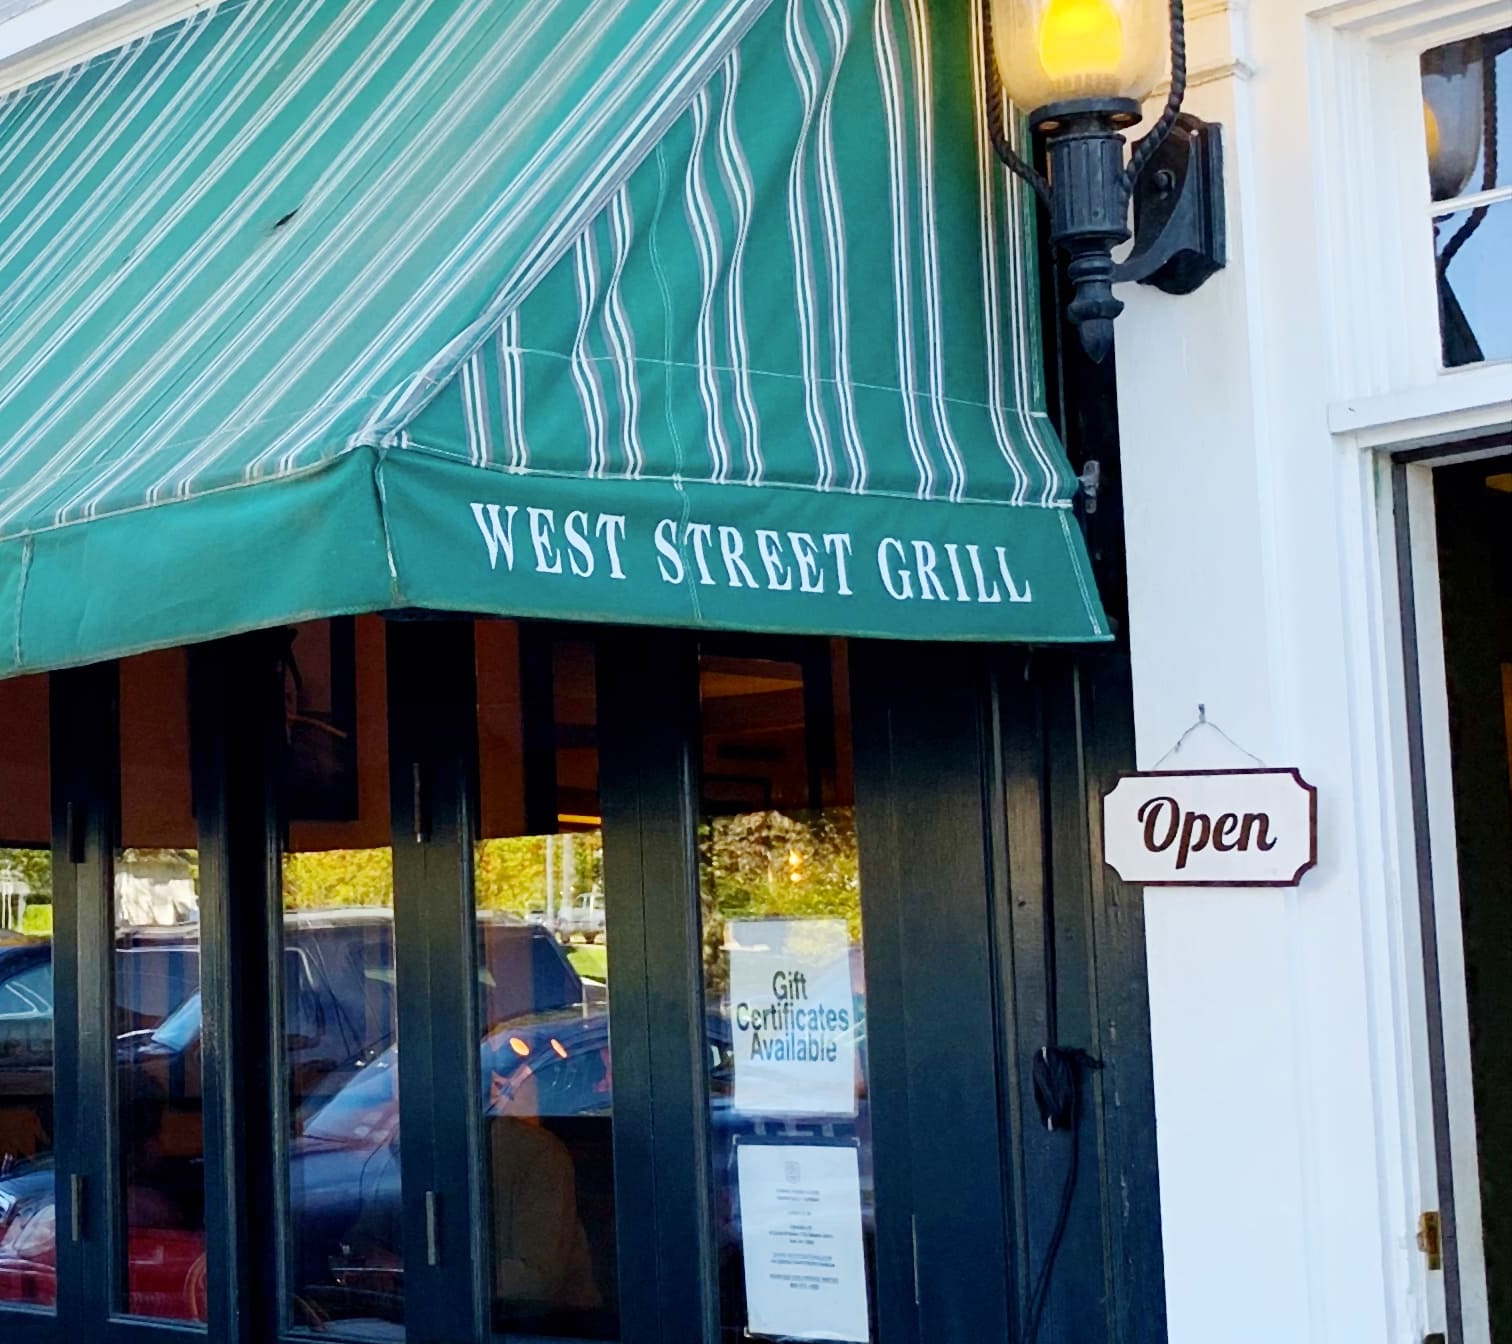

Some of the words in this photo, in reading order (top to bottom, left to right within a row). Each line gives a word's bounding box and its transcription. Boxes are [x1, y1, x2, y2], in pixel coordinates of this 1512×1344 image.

[469, 501, 627, 580] WEST
[654, 517, 855, 597] STREET
[877, 536, 1033, 603] GRILL
[1138, 796, 1277, 869] Open
[772, 970, 808, 1000] Gift
[736, 1002, 849, 1031] Certificates
[750, 1032, 837, 1062] Available
